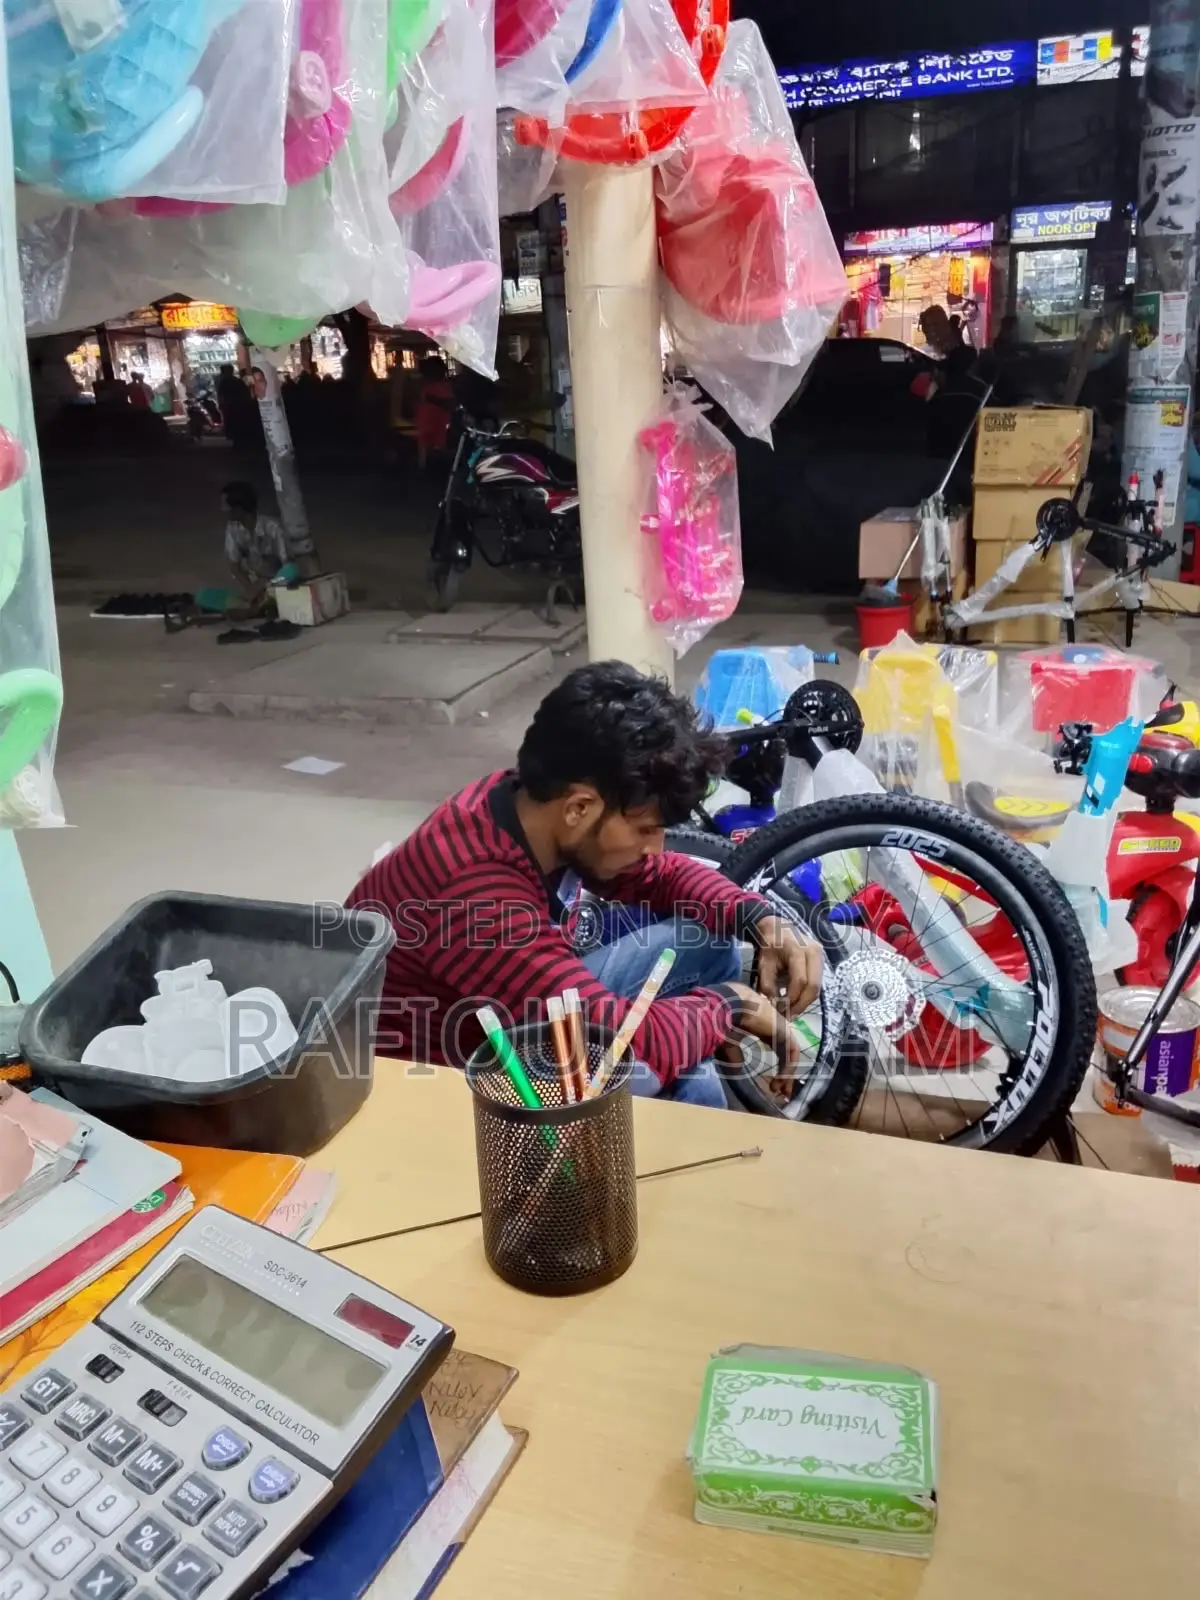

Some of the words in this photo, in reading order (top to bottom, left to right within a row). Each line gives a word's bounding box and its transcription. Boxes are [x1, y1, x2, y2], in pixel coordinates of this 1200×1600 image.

[800, 76, 912, 99] COMMERCE
[918, 69, 973, 86] BANK
[976, 65, 1015, 80] LTD.
[1038, 222, 1072, 236] NOOR
[880, 827, 950, 858] 2025
[983, 979, 1055, 1133] POLLUX
[263, 1260, 308, 1288] SDC-3614
[410, 1334, 427, 1347] 14
[32, 1376, 60, 1397] GT
[129, 1320, 147, 1335] 112
[144, 1329, 175, 1352] STEPS
[173, 1347, 204, 1373] CHECK
[209, 1370, 256, 1403] CORRECT
[254, 1399, 321, 1446] CALCULATOR
[64, 1400, 96, 1424] MRC
[735, 1405, 794, 1427] Card
[799, 1404, 887, 1439] Visiting
[101, 1424, 126, 1444] M-
[215, 1433, 239, 1451] CHECK
[27, 1440, 48, 1457] 7
[135, 1450, 164, 1472] M+
[61, 1467, 81, 1486] 8
[262, 1464, 287, 1484] CHECK
[96, 1494, 117, 1512] 9
[16, 1505, 38, 1525] 5
[227, 1510, 247, 1527] AUTO
[135, 1525, 160, 1551] %
[214, 1518, 242, 1539] REPLAY
[51, 1536, 72, 1555] 6
